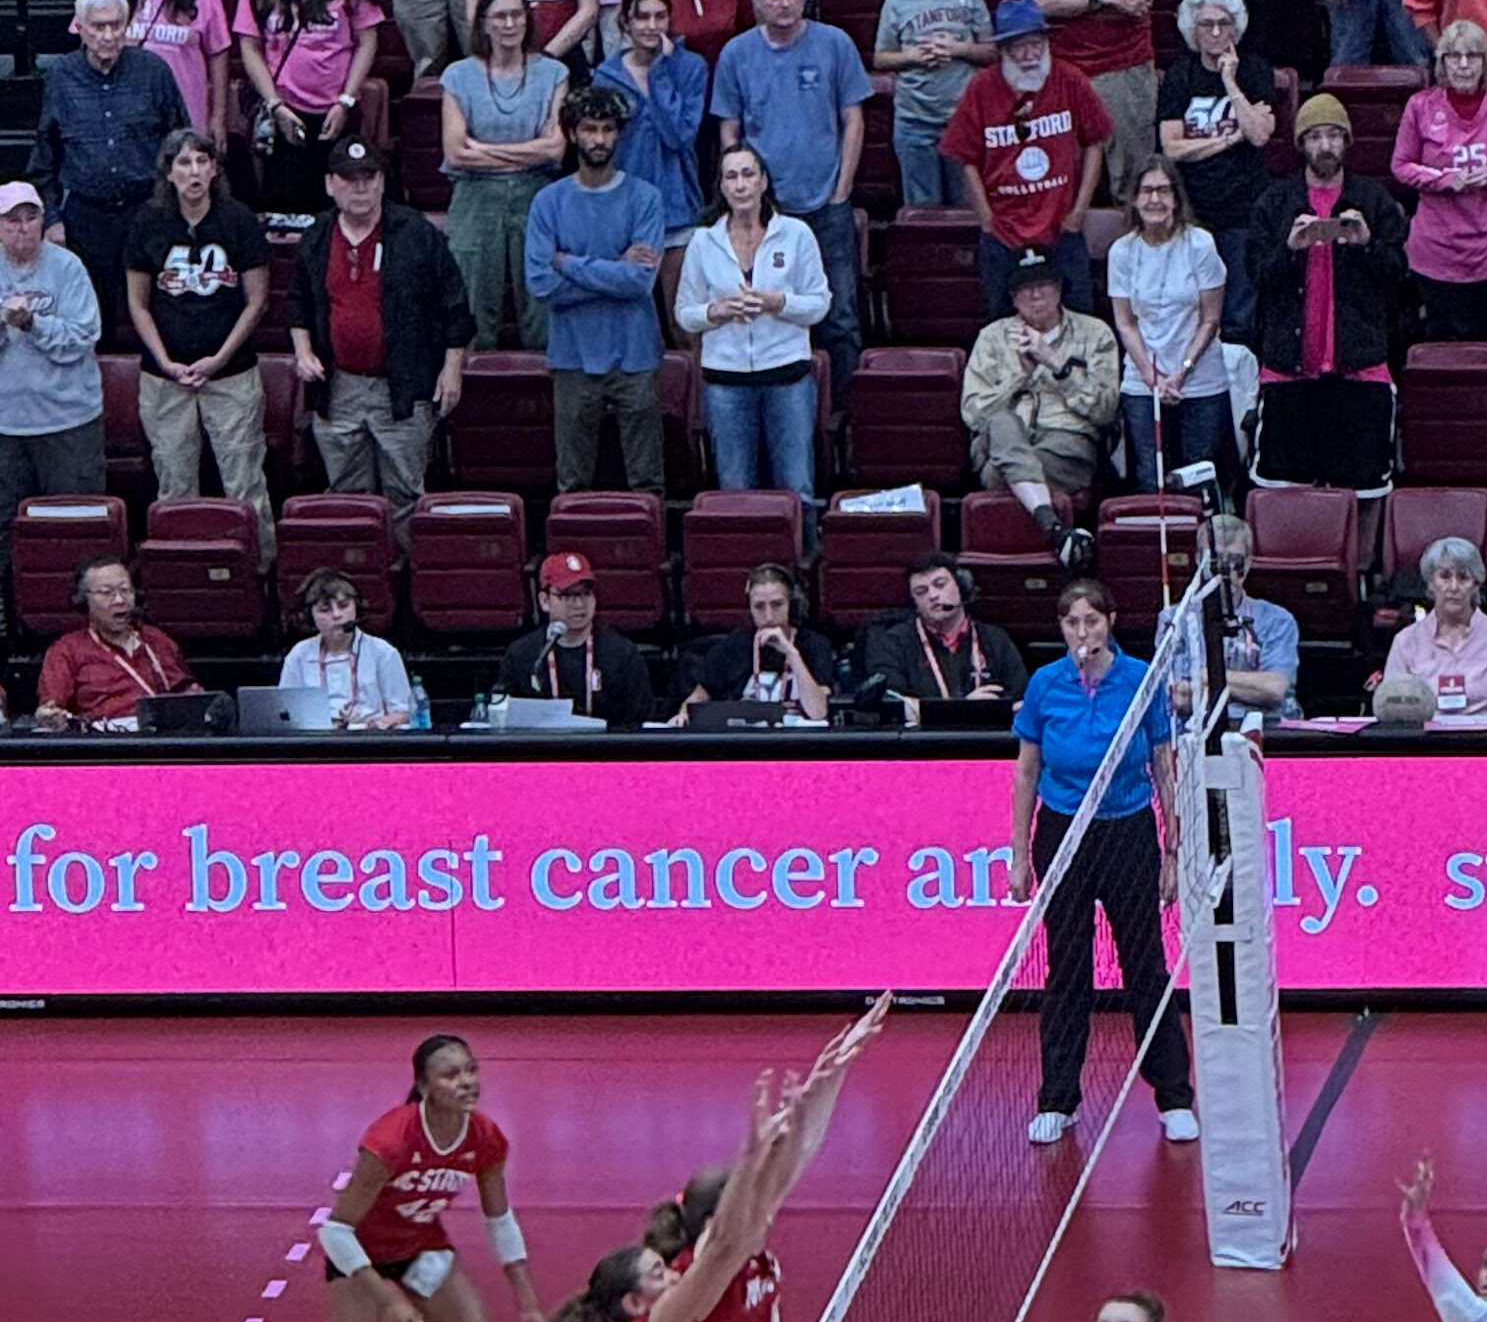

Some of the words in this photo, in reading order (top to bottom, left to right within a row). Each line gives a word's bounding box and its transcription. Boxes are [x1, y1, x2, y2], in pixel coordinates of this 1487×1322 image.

[984, 110, 1073, 148] STAFORD
[1452, 142, 1487, 167] 25
[7, 823, 157, 915] for
[182, 824, 505, 914] breast
[530, 846, 878, 912] cancer
[1223, 1200, 1267, 1216] ACC
